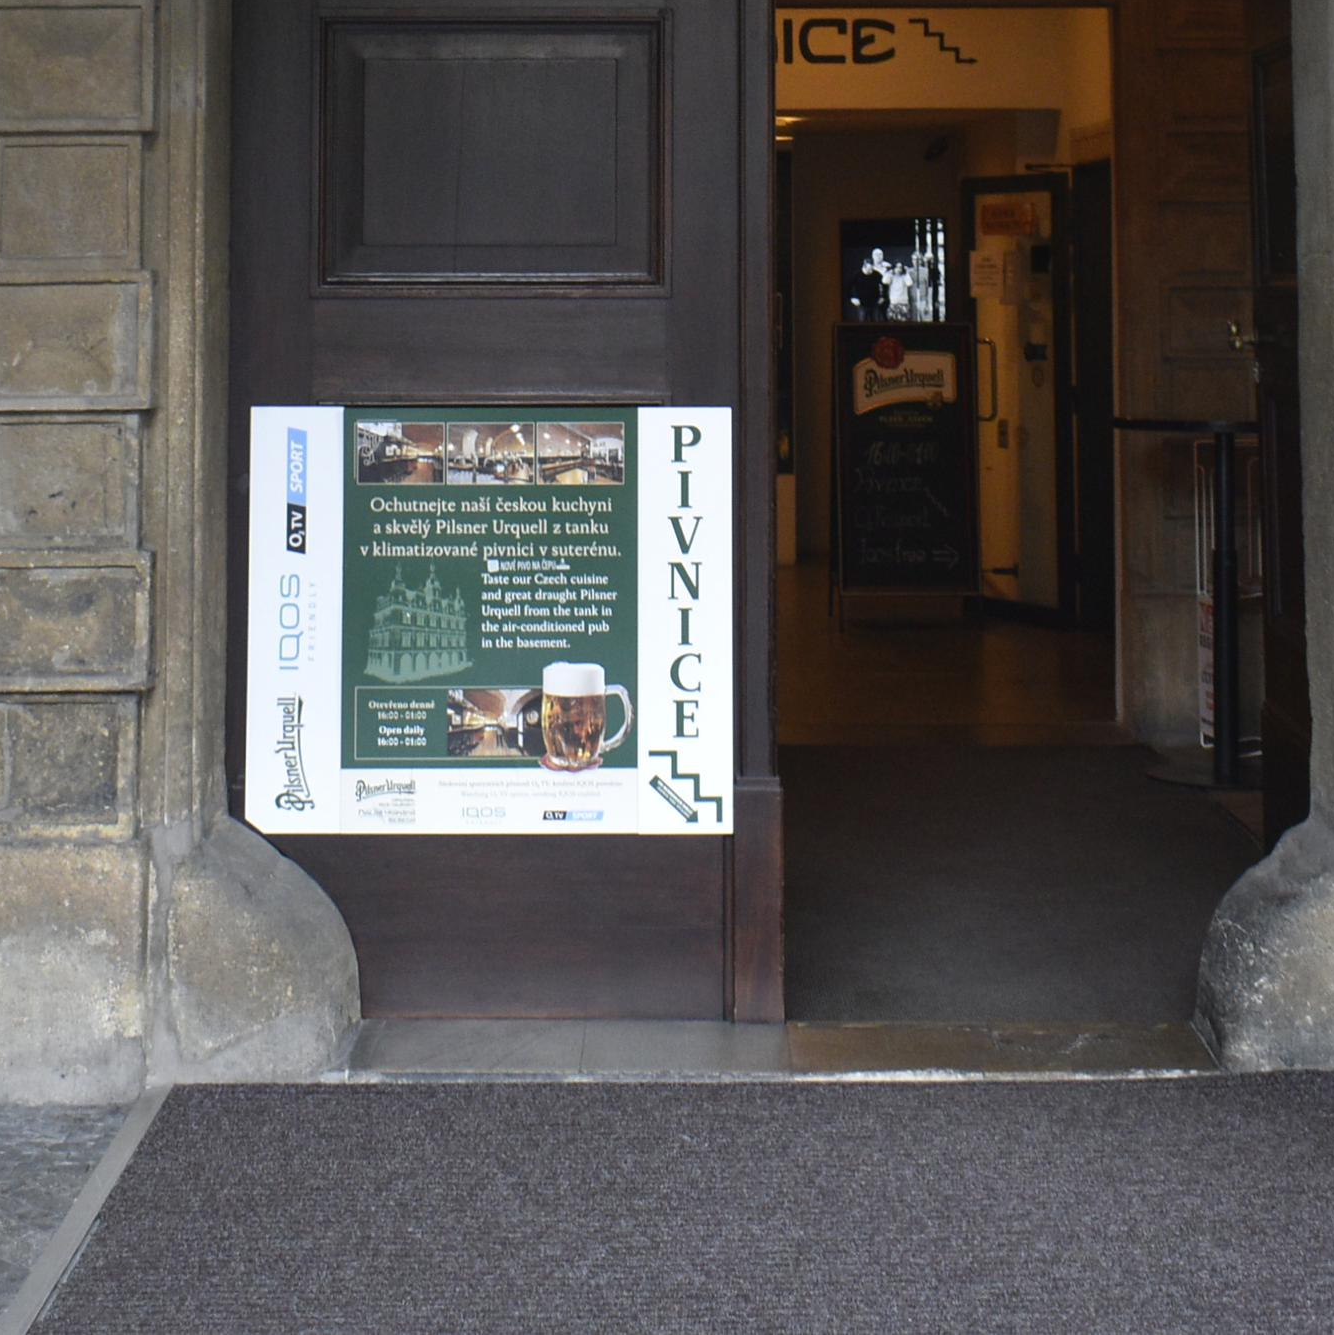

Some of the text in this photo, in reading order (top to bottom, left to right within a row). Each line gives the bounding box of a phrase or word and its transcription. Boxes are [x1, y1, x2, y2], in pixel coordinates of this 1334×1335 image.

[775, 18, 896, 64] ICE
[290, 439, 304, 494] SPORT
[370, 495, 612, 516] Ochutnejte naší českou kuchyni
[373, 518, 609, 539] a skvělý Pilsner Urquell z tanku
[360, 540, 622, 561] v klimatizované pivnici v suterénu.
[481, 573, 608, 585] Taste our Czech cuisine
[667, 424, 704, 738] PIVNICE
[481, 588, 618, 604] and great draught Pilsner
[481, 604, 612, 620] Urquell from the tank in
[279, 573, 304, 670] IQOS
[481, 620, 610, 636] the air-conditioned pub
[481, 636, 571, 648] in the basement.
[377, 710, 399, 720] 16:00
[378, 724, 425, 737] Open daily
[377, 737, 399, 747] 16:00
[275, 696, 315, 811] Pilsner Urquell
